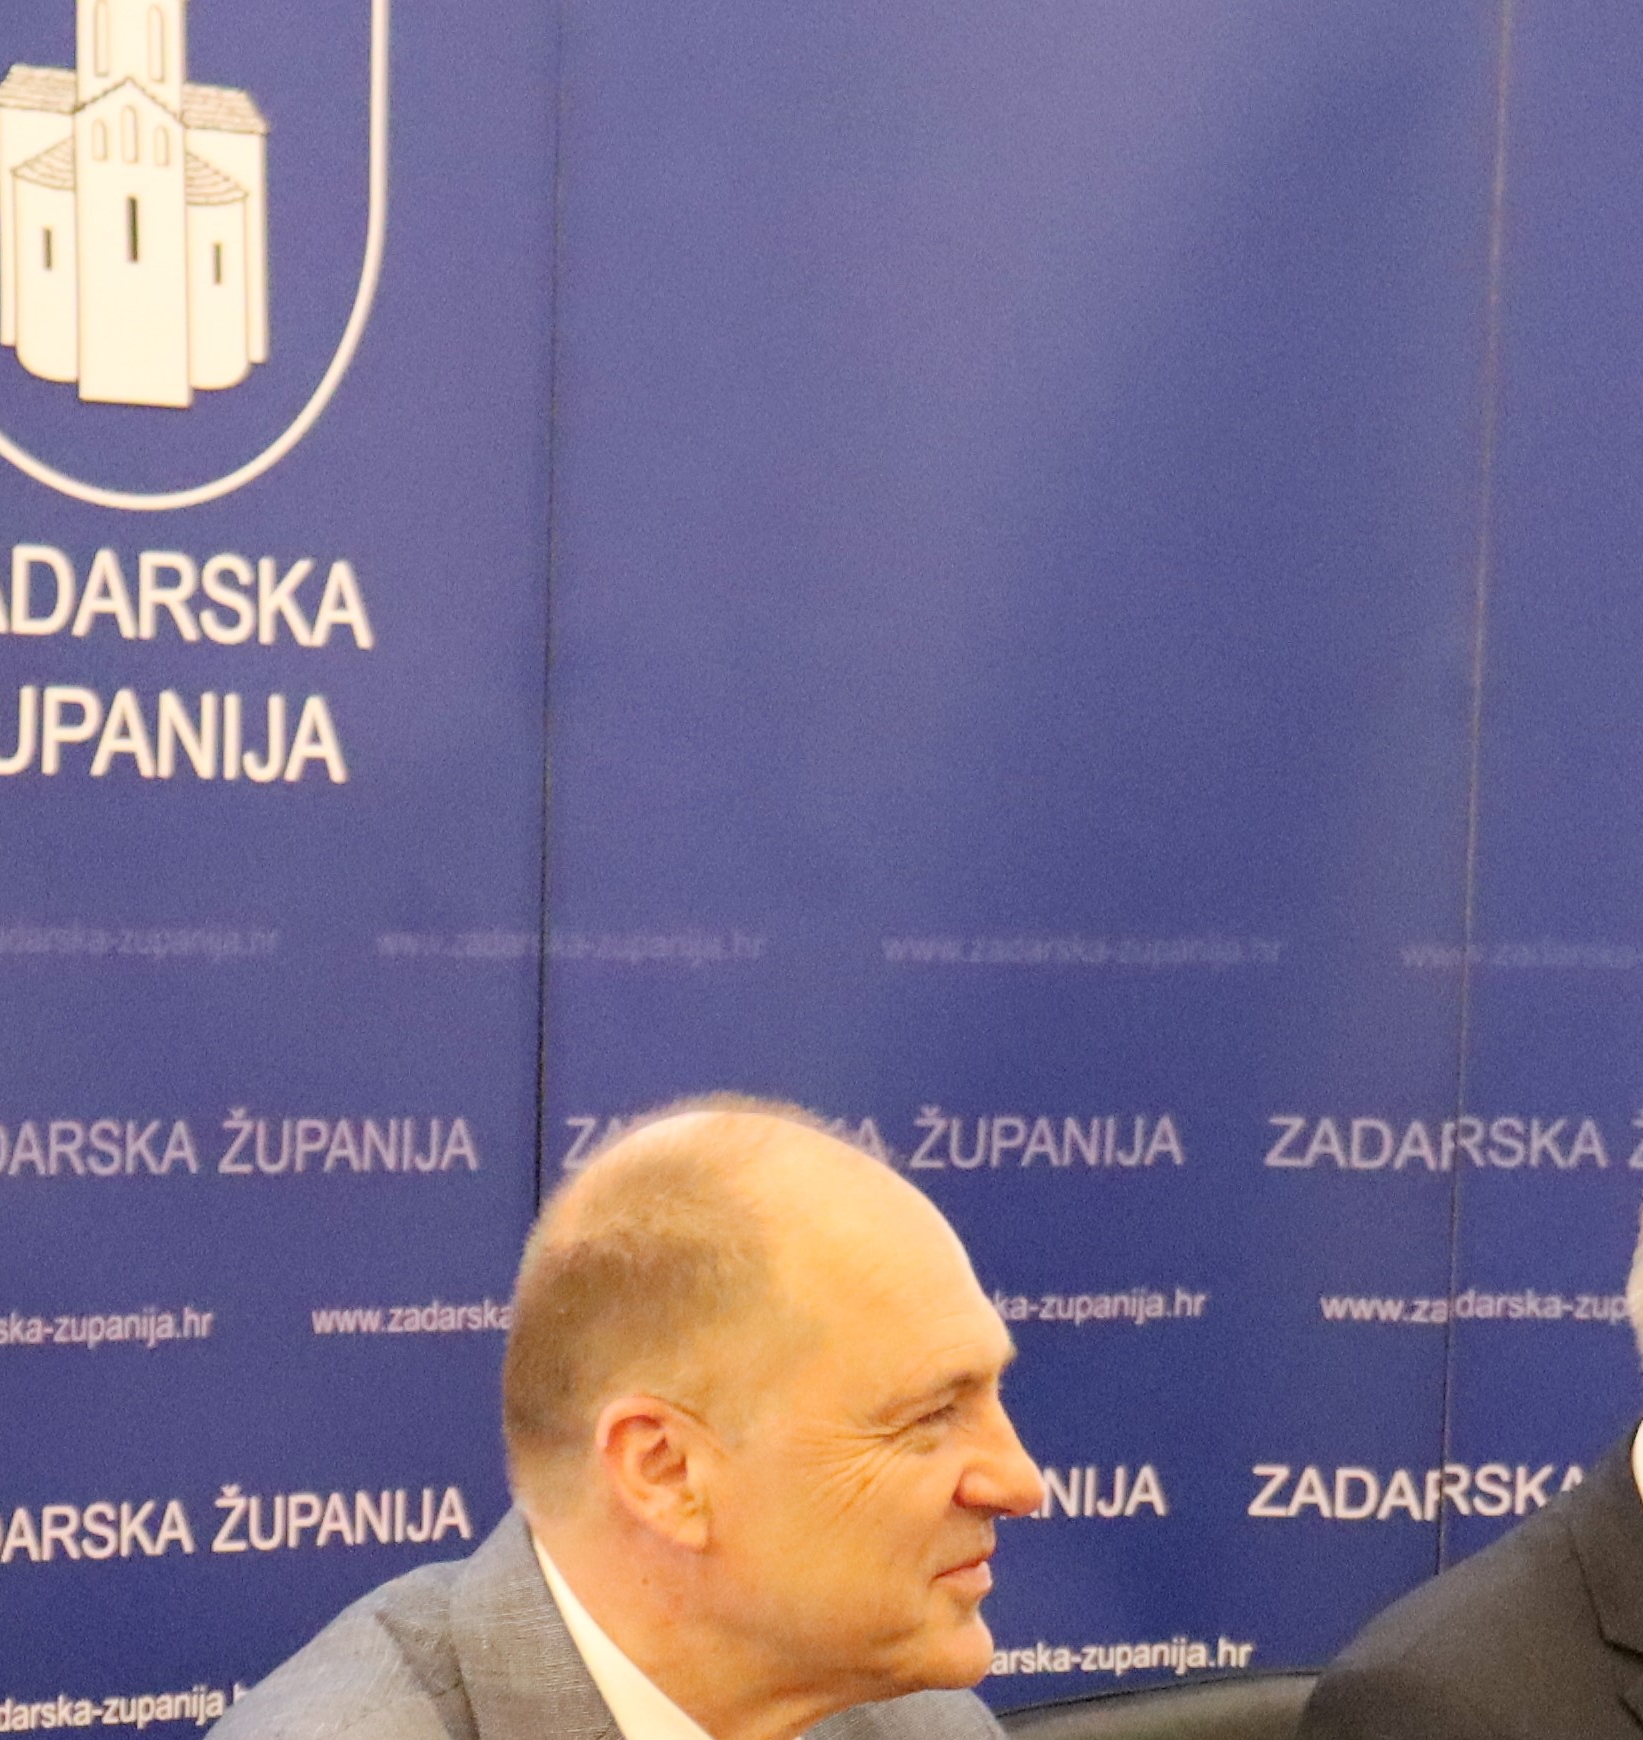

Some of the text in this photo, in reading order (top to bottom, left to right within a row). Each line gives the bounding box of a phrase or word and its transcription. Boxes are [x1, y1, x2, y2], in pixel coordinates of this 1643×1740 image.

[218, 1107, 479, 1175] ŽUPANIJA
[910, 1105, 1185, 1169] ŽUPANIJA
[1265, 1115, 1608, 1172] ZADARSKA
[212, 1483, 474, 1553] ŽUPANIJA
[1030, 1463, 1169, 1519] NIJA
[987, 1636, 1253, 1677] arska-zupanija.hr
